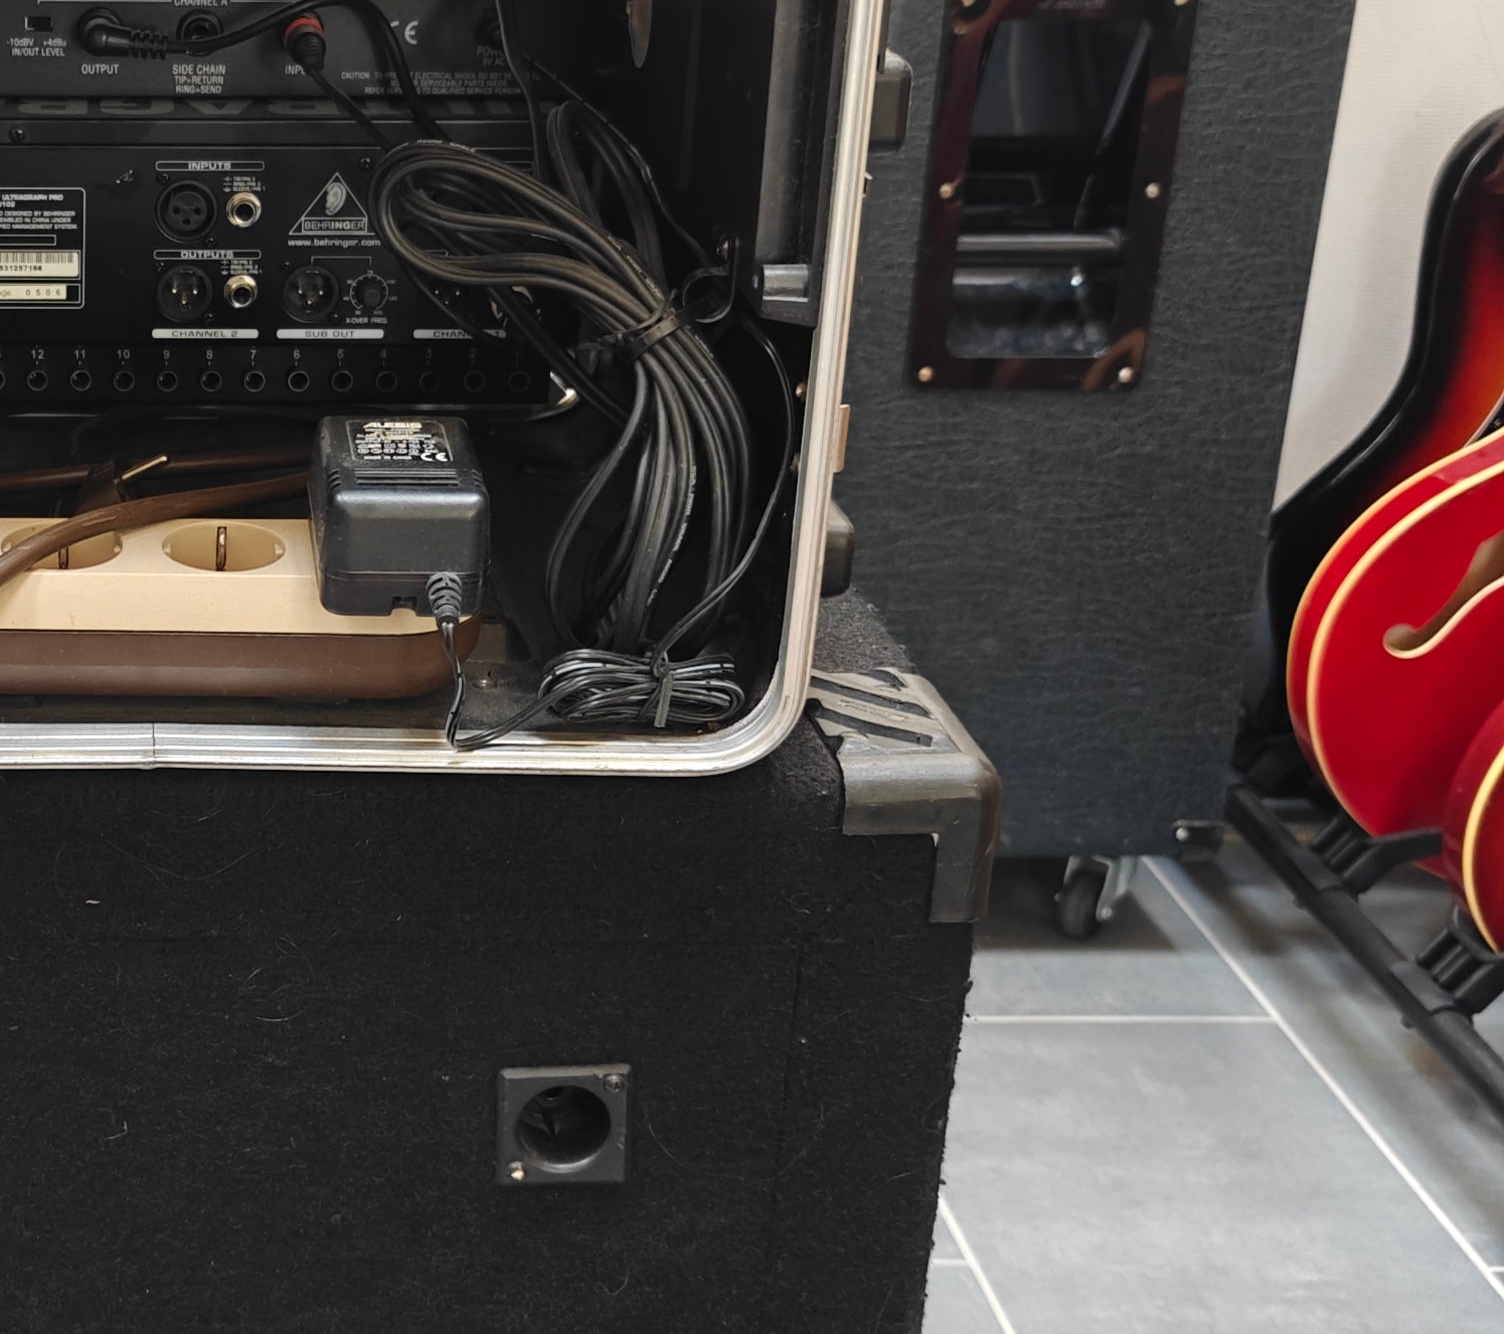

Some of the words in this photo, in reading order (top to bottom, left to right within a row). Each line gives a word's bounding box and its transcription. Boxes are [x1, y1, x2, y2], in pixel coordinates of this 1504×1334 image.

[12, 47, 39, 56] IN/OUT
[42, 47, 65, 56] LEVEL
[81, 64, 119, 74] OUTPUT
[173, 65, 193, 74] SIDE
[196, 65, 225, 74] CHAIN
[188, 162, 231, 170] INPUTS
[304, 220, 365, 230] BEHRINGER
[288, 239, 380, 247] www.behringer.com
[181, 251, 233, 259] OUTPUTS
[31, 349, 44, 359] 12
[74, 349, 86, 359] 11
[117, 350, 130, 359] 10
[164, 349, 170, 359] 9
[207, 349, 213, 359] 8
[250, 349, 256, 359] 7
[294, 349, 300, 359] 6
